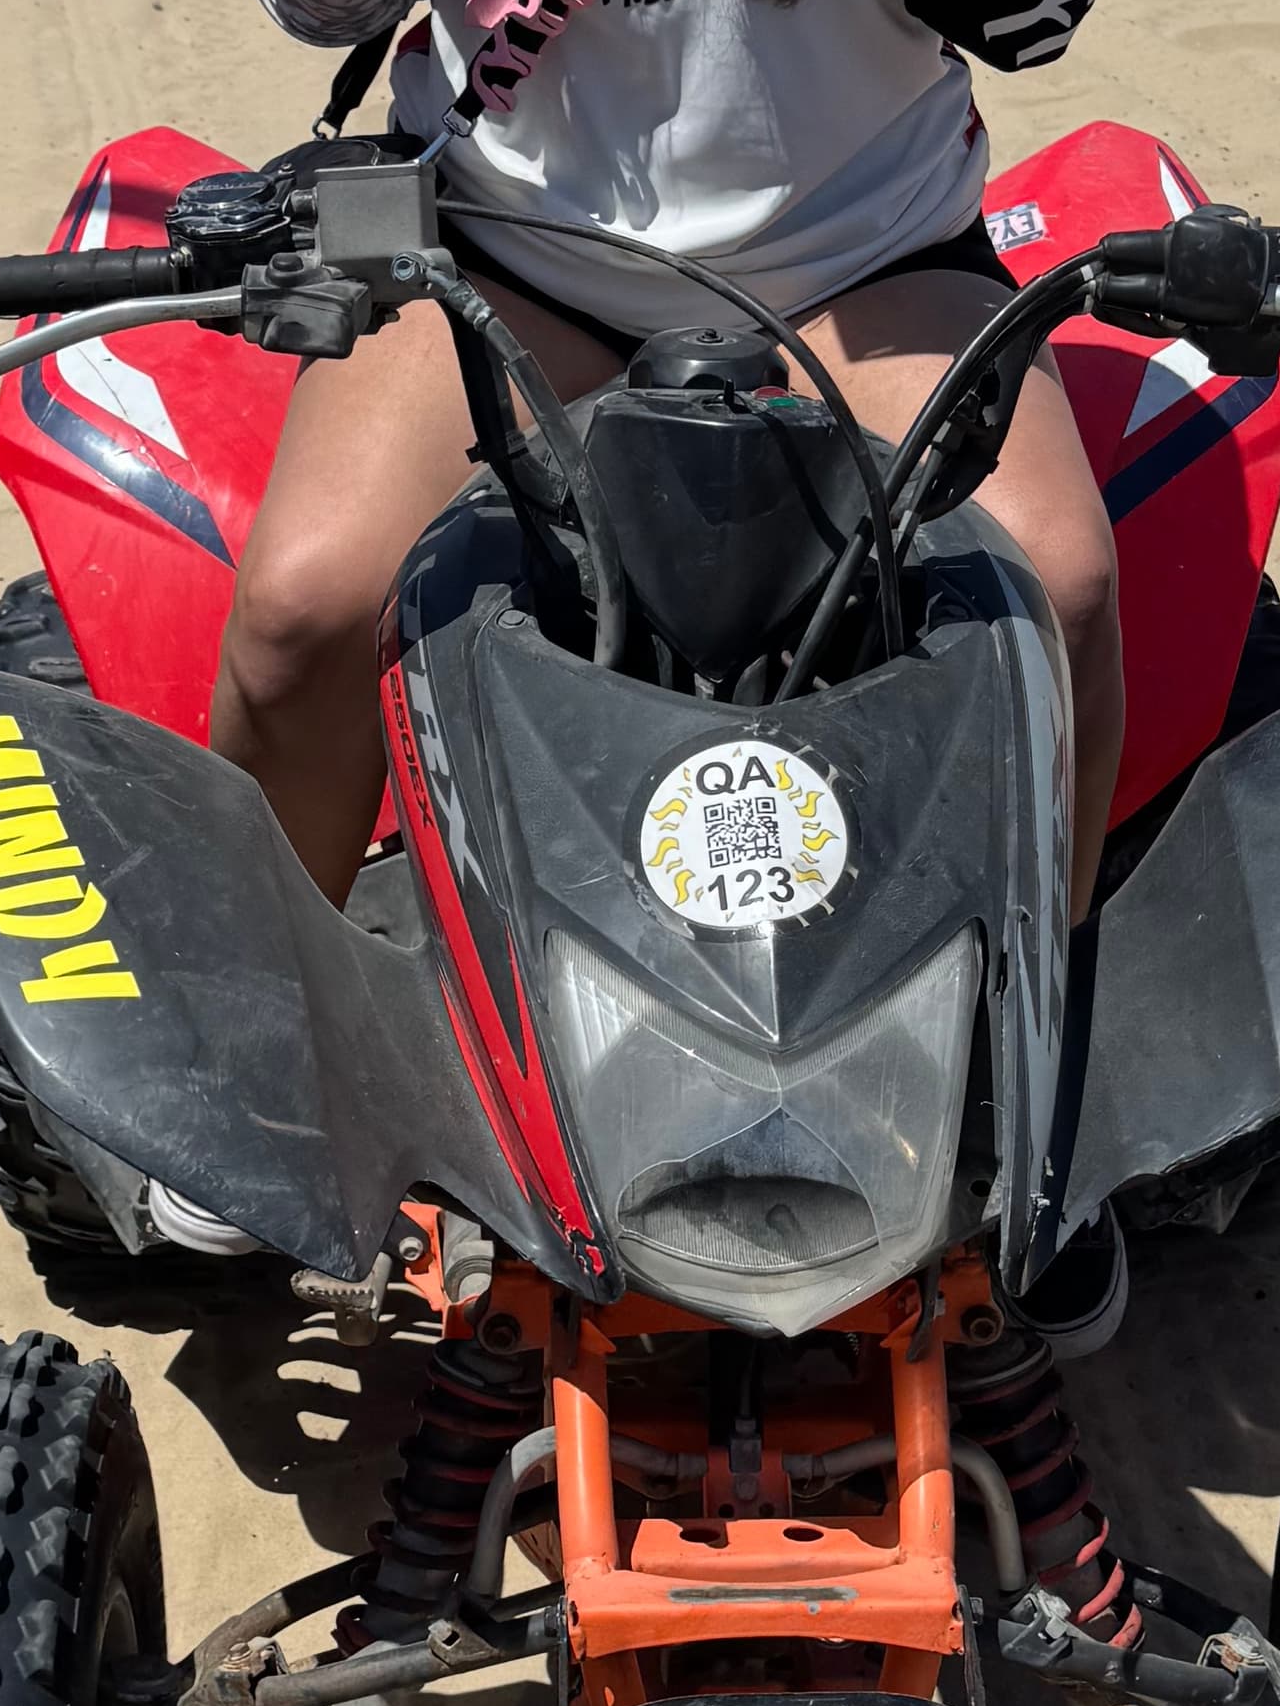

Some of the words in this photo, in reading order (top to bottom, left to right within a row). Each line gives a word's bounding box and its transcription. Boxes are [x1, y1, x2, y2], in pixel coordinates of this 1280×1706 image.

[388, 668, 435, 830] 250EX
[695, 755, 776, 796] QA
[707, 866, 796, 911] 123
